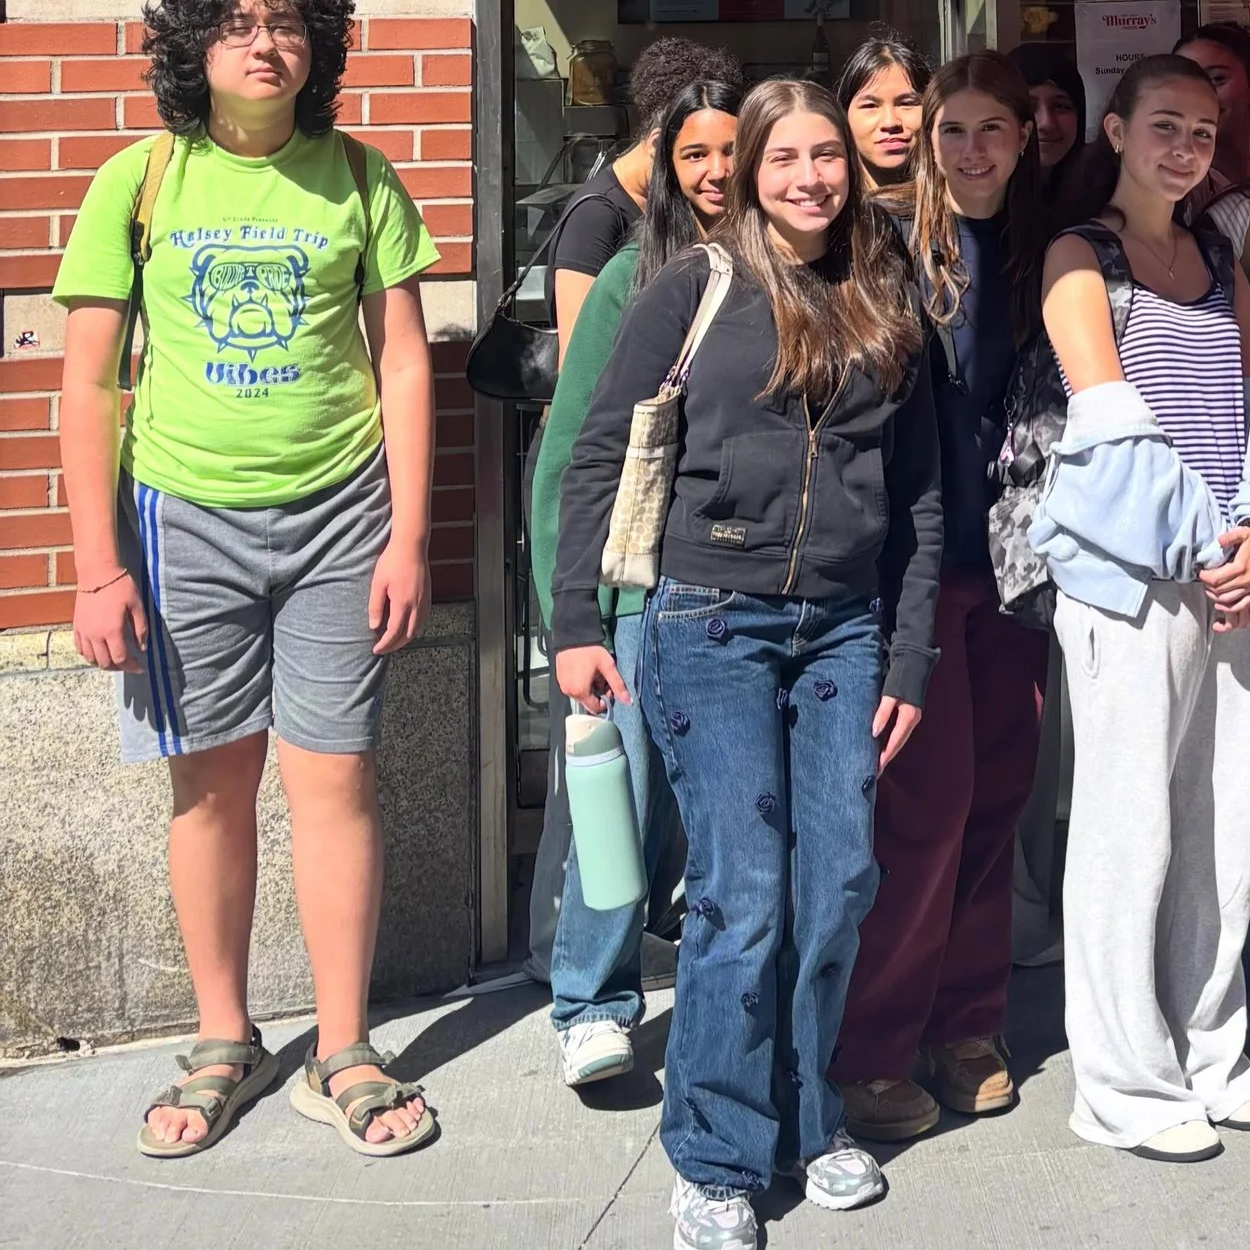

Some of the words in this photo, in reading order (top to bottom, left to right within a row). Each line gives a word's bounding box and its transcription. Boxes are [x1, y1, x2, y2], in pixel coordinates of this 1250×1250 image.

[1102, 14, 1157, 29] Murray's
[1095, 67, 1125, 75] Sunday
[170, 227, 232, 248] Halsey
[240, 225, 285, 240] Field
[293, 228, 329, 249] Trip
[236, 388, 269, 398] 2024
